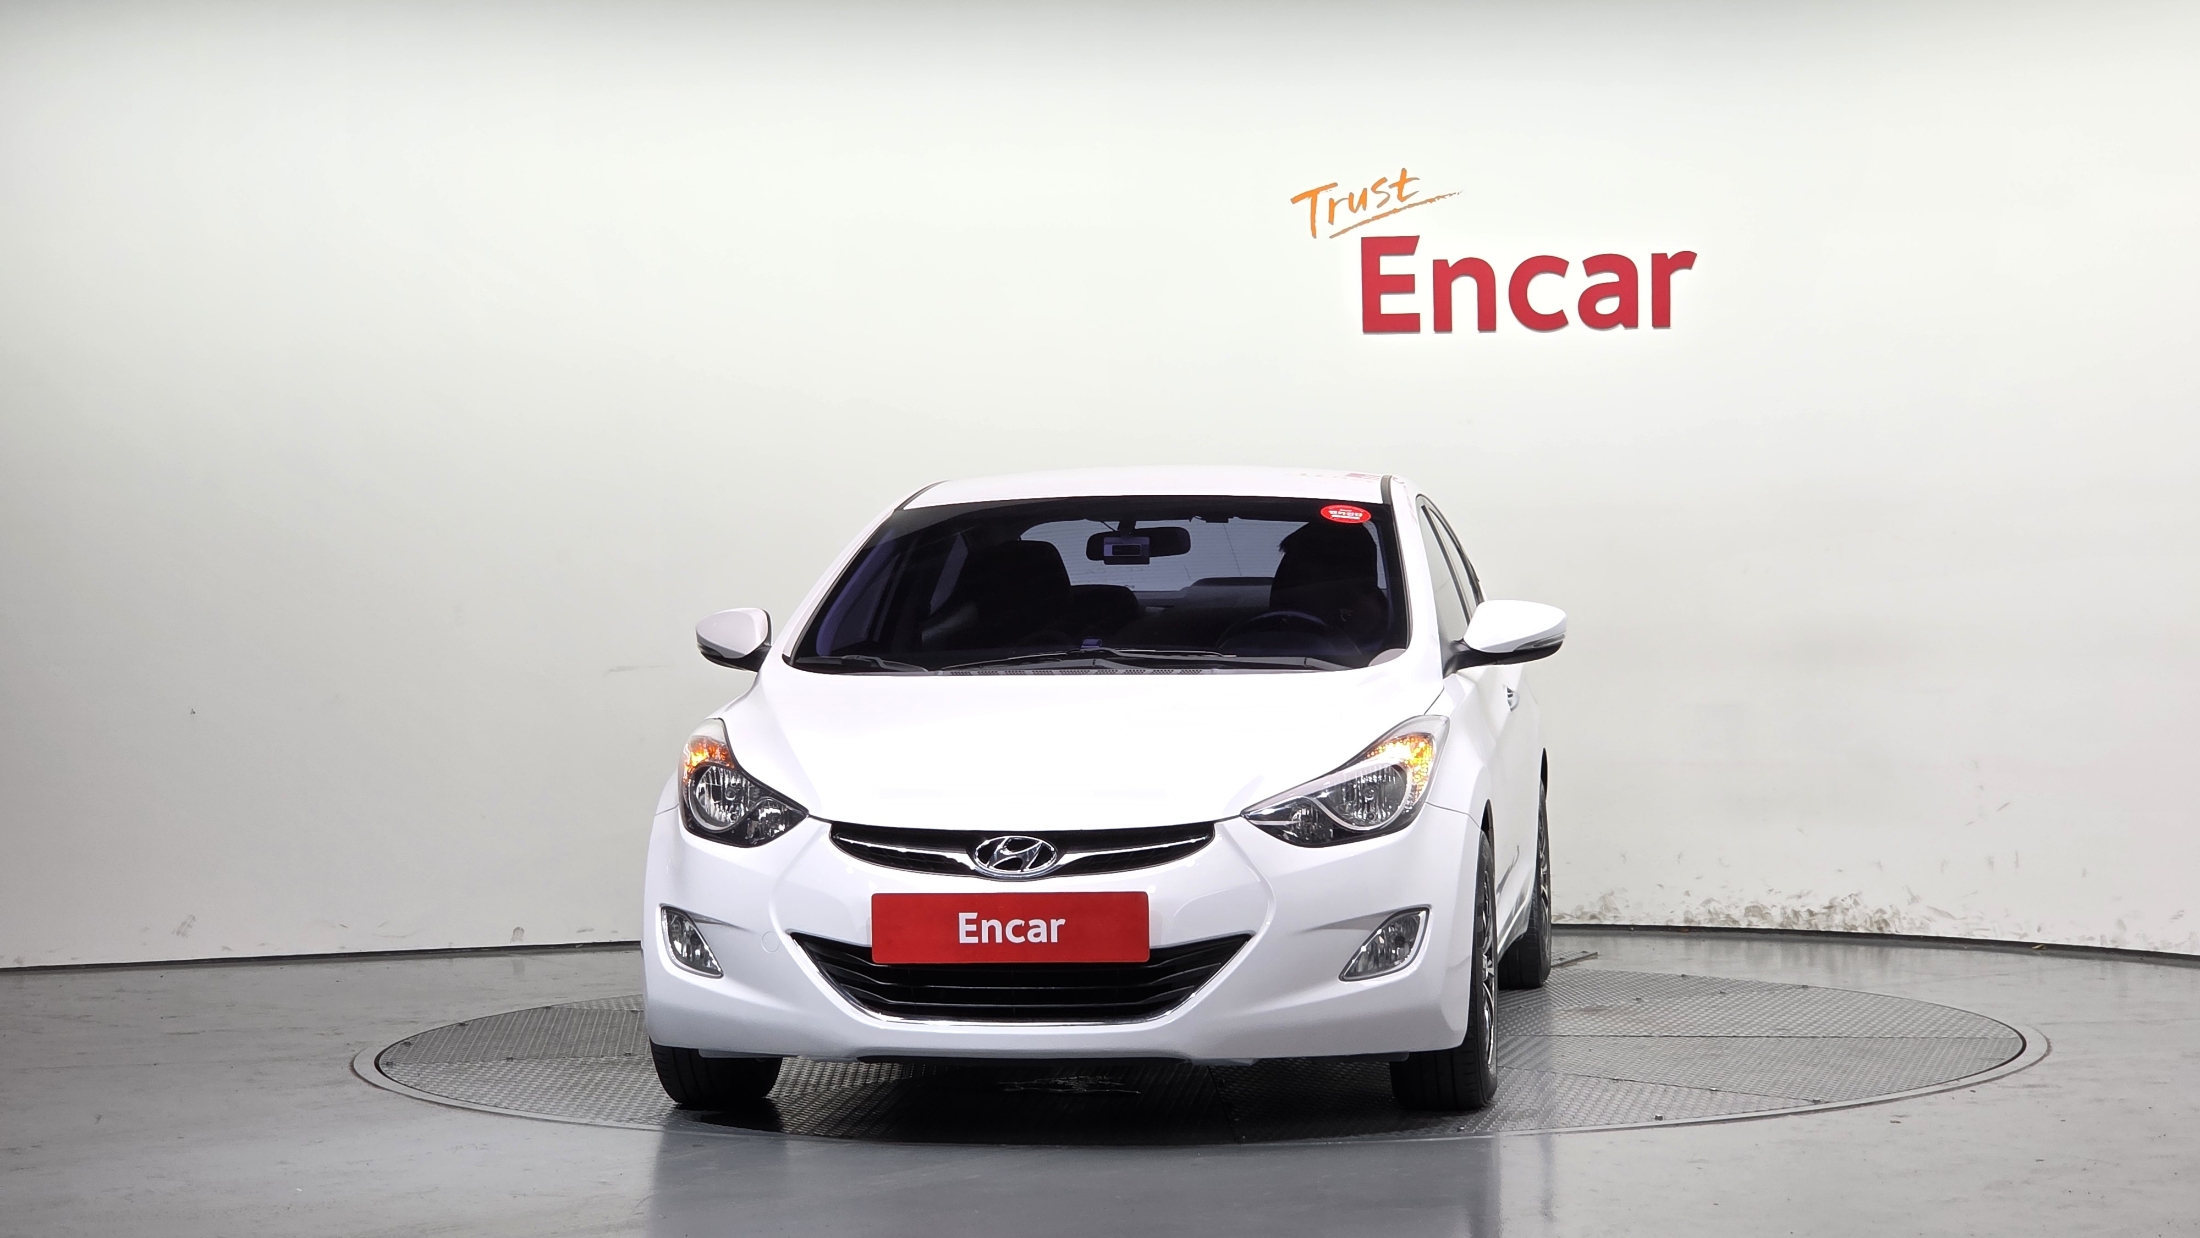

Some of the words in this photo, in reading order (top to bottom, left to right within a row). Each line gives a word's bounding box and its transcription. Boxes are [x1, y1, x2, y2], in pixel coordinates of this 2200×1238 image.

[1290, 168, 1420, 240] Trust
[1361, 235, 1697, 333] Encar
[958, 912, 1066, 944] Encar
